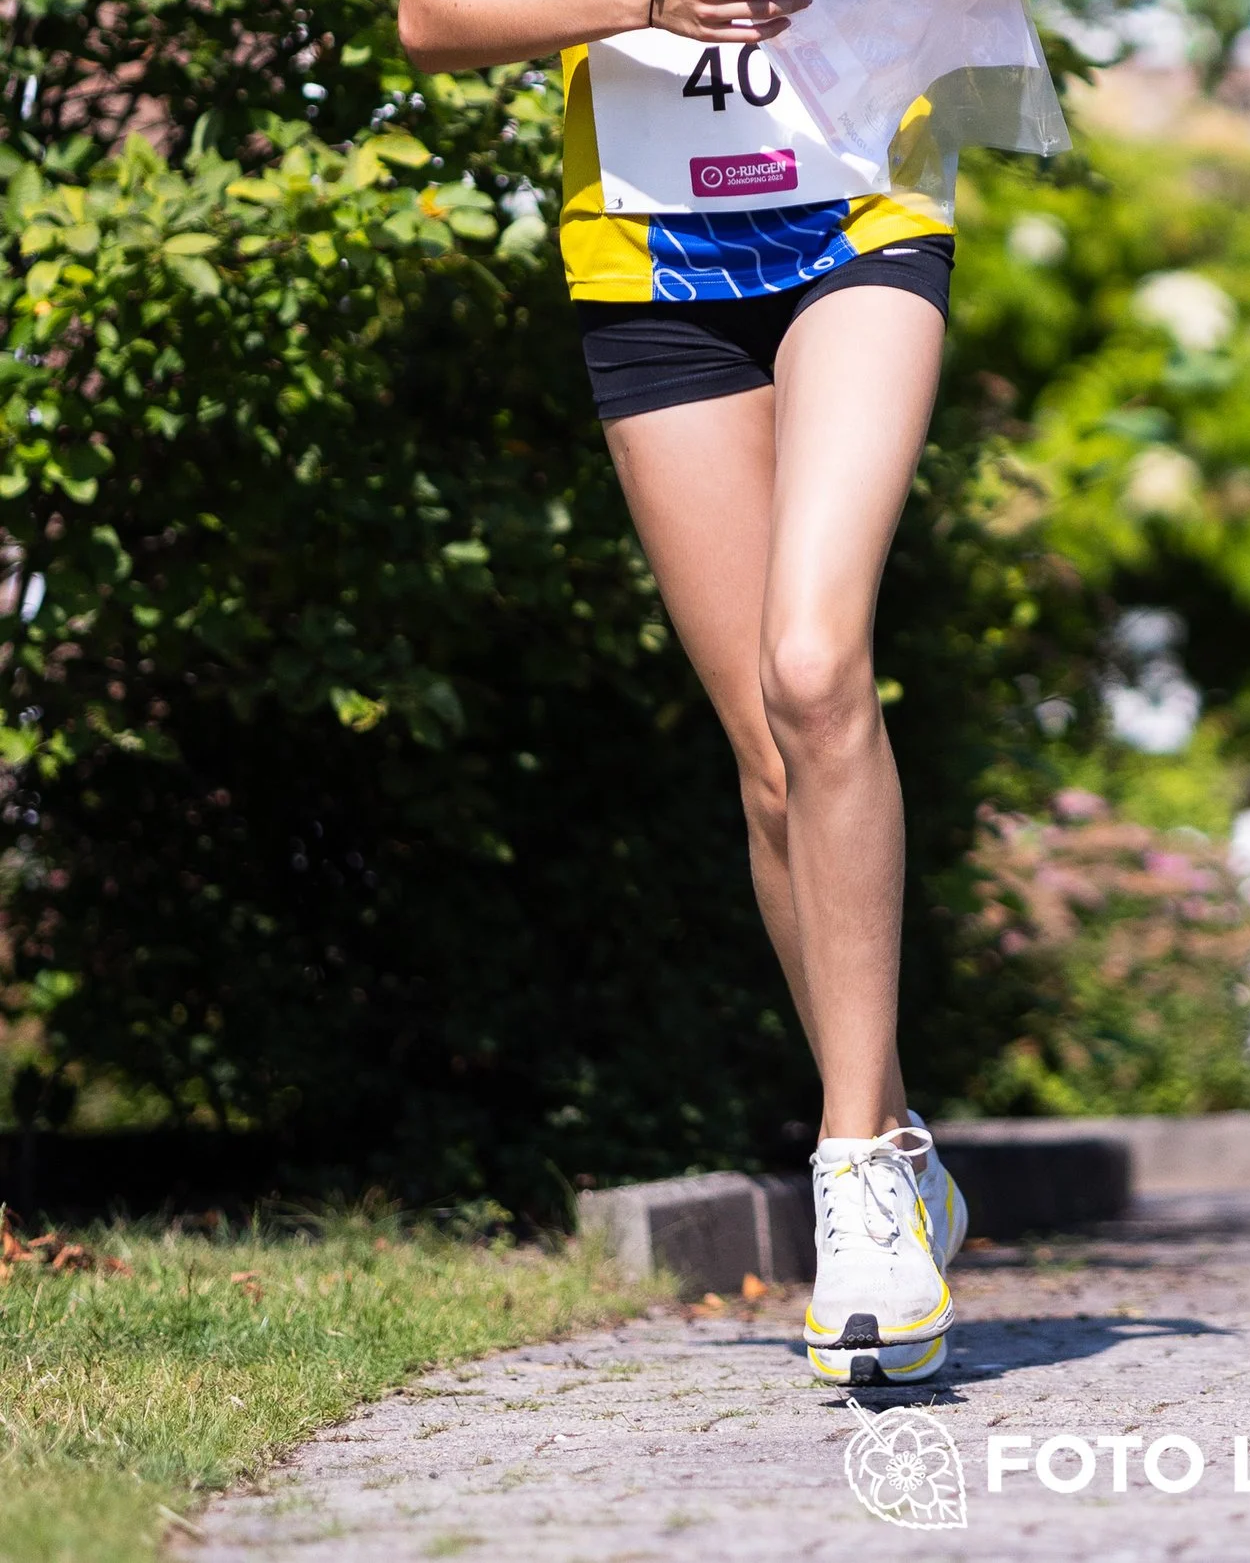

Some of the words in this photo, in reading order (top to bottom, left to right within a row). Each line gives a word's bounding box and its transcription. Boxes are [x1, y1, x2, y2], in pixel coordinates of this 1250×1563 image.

[682, 42, 781, 112] 40
[725, 160, 787, 177] O-RINGEN
[767, 173, 784, 182] 2025
